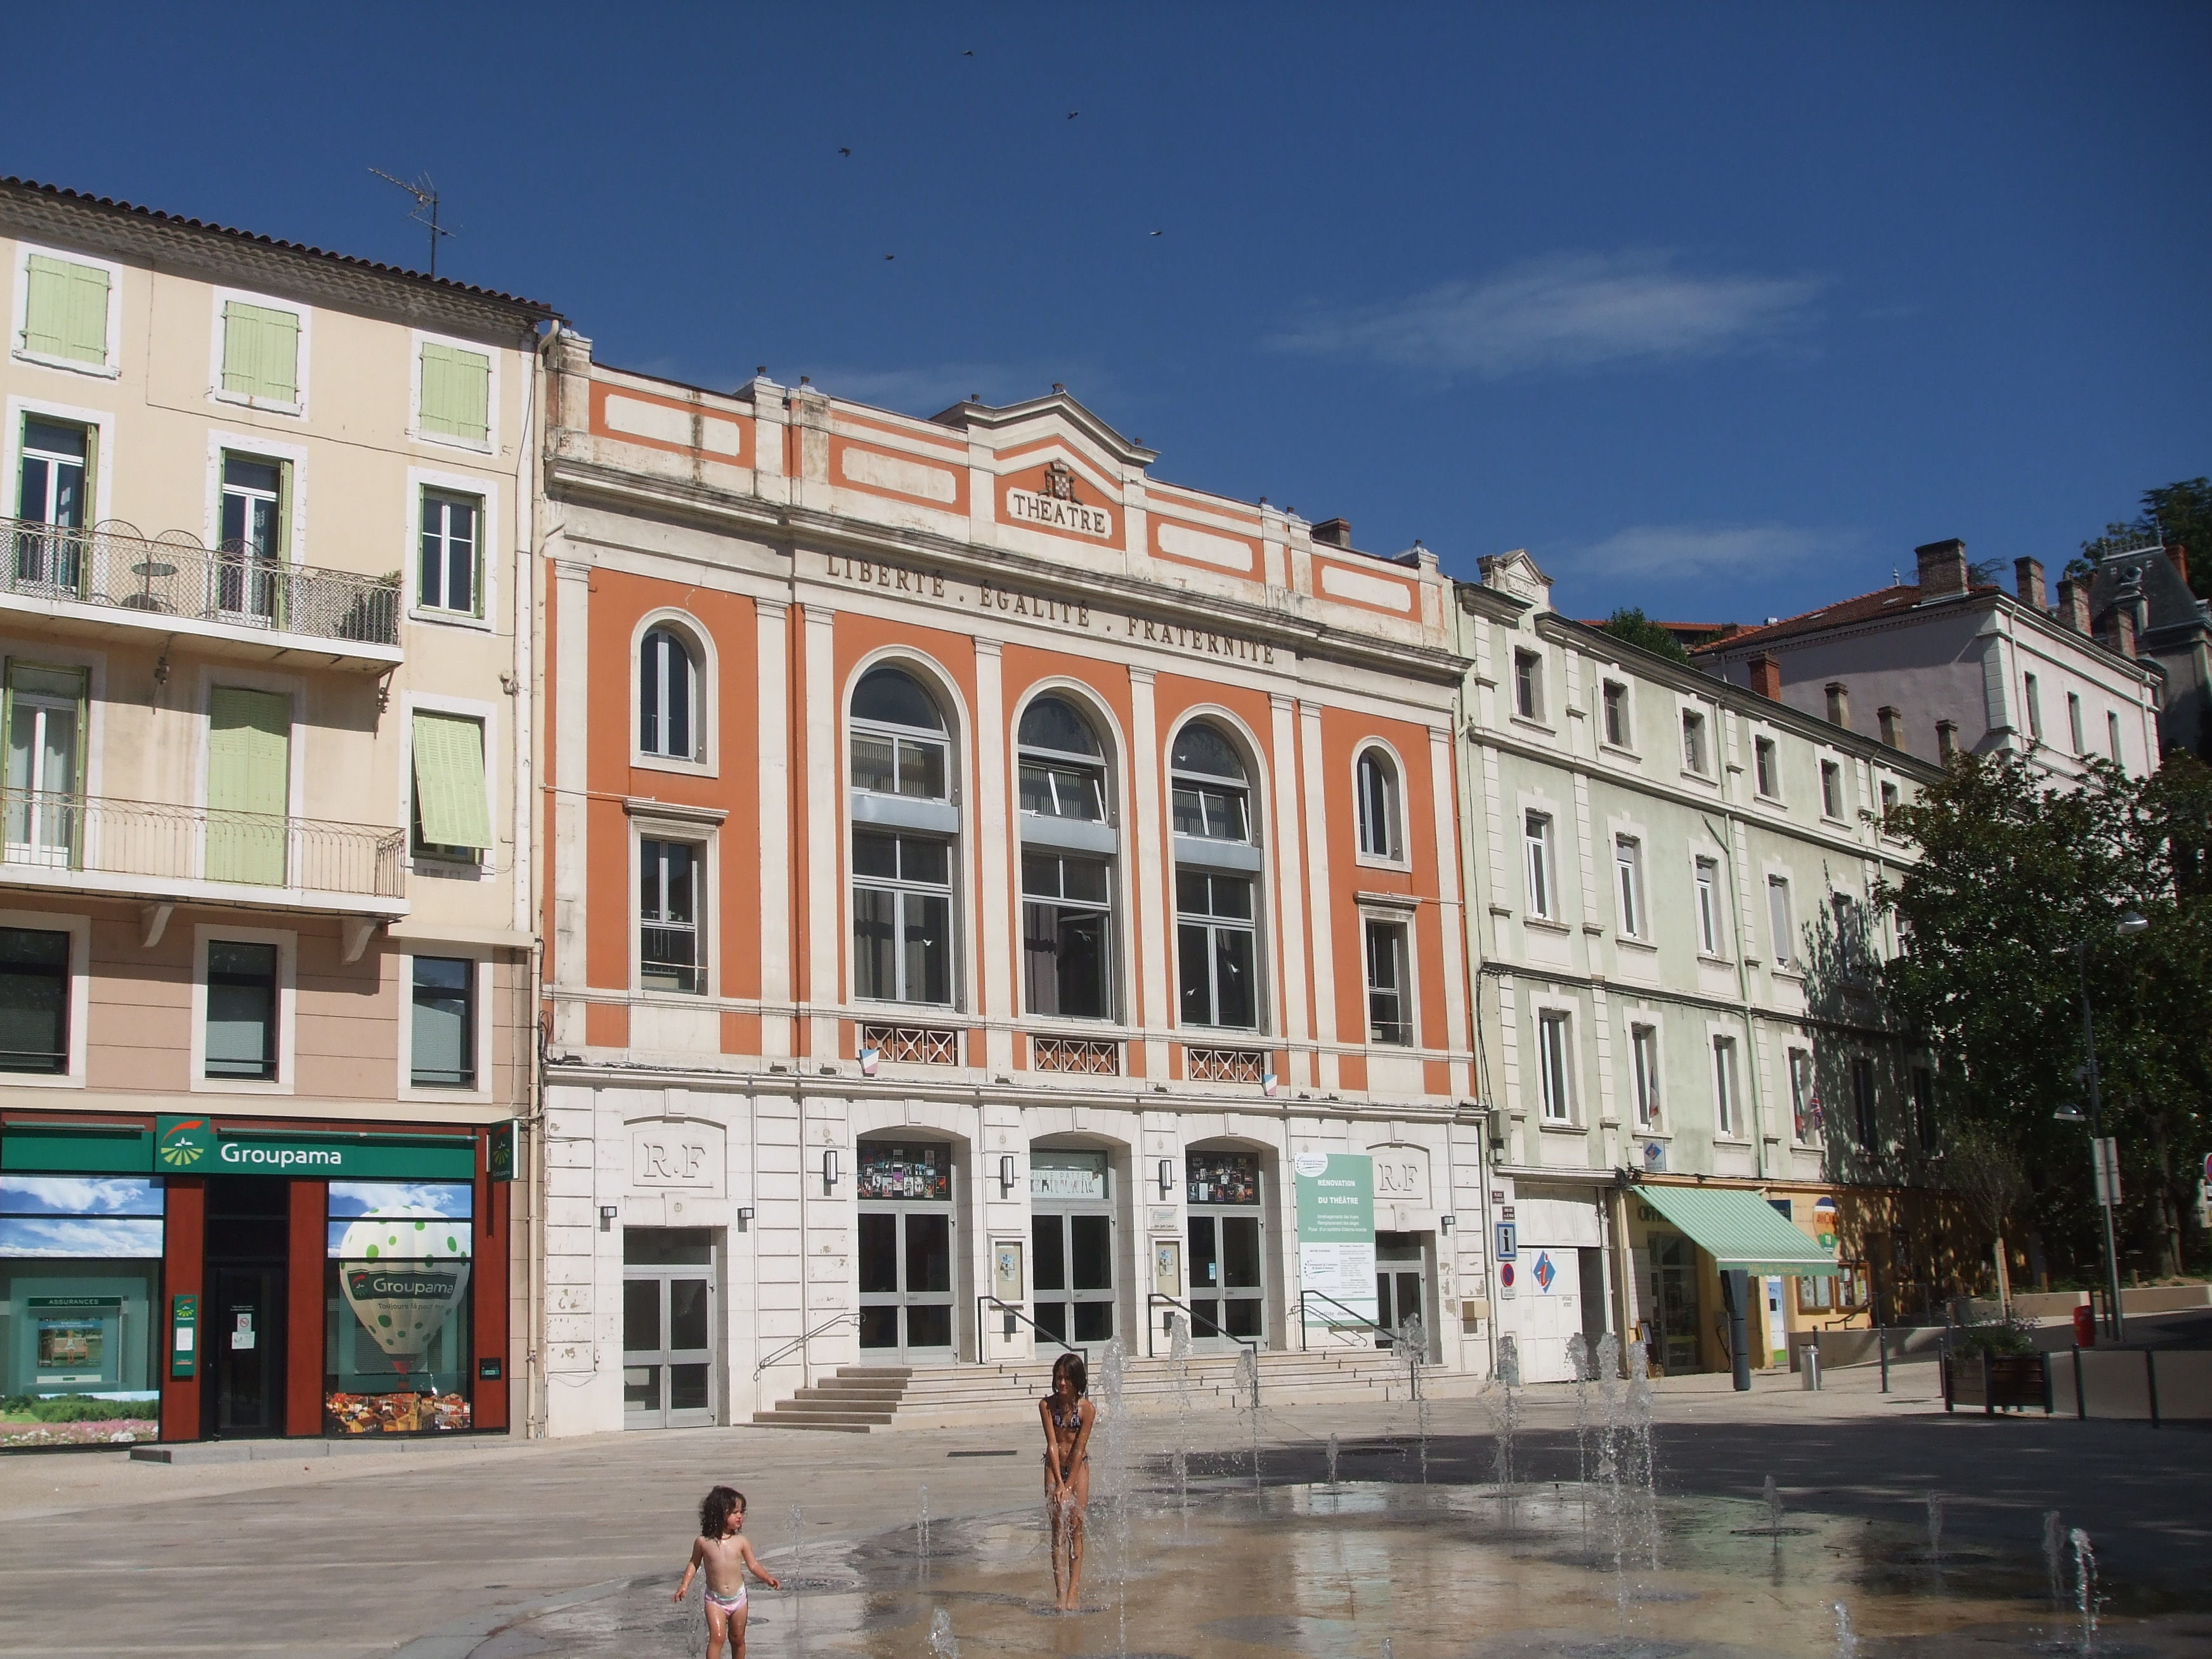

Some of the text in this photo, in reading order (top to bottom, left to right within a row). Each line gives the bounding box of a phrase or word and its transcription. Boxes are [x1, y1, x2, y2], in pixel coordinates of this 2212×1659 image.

[1013, 493, 1105, 533] THEATRE
[826, 552, 945, 597] LIBERTÉ
[979, 579, 1090, 627] ÉGALITÉ
[220, 1143, 342, 1168] Groupama
[1059, 1171, 1091, 1180] PATTES
[1317, 1178, 1356, 1187] RÉNOVATION
[1329, 1195, 1358, 1204] THÉÂTRE
[373, 1277, 453, 1295] Groupama
